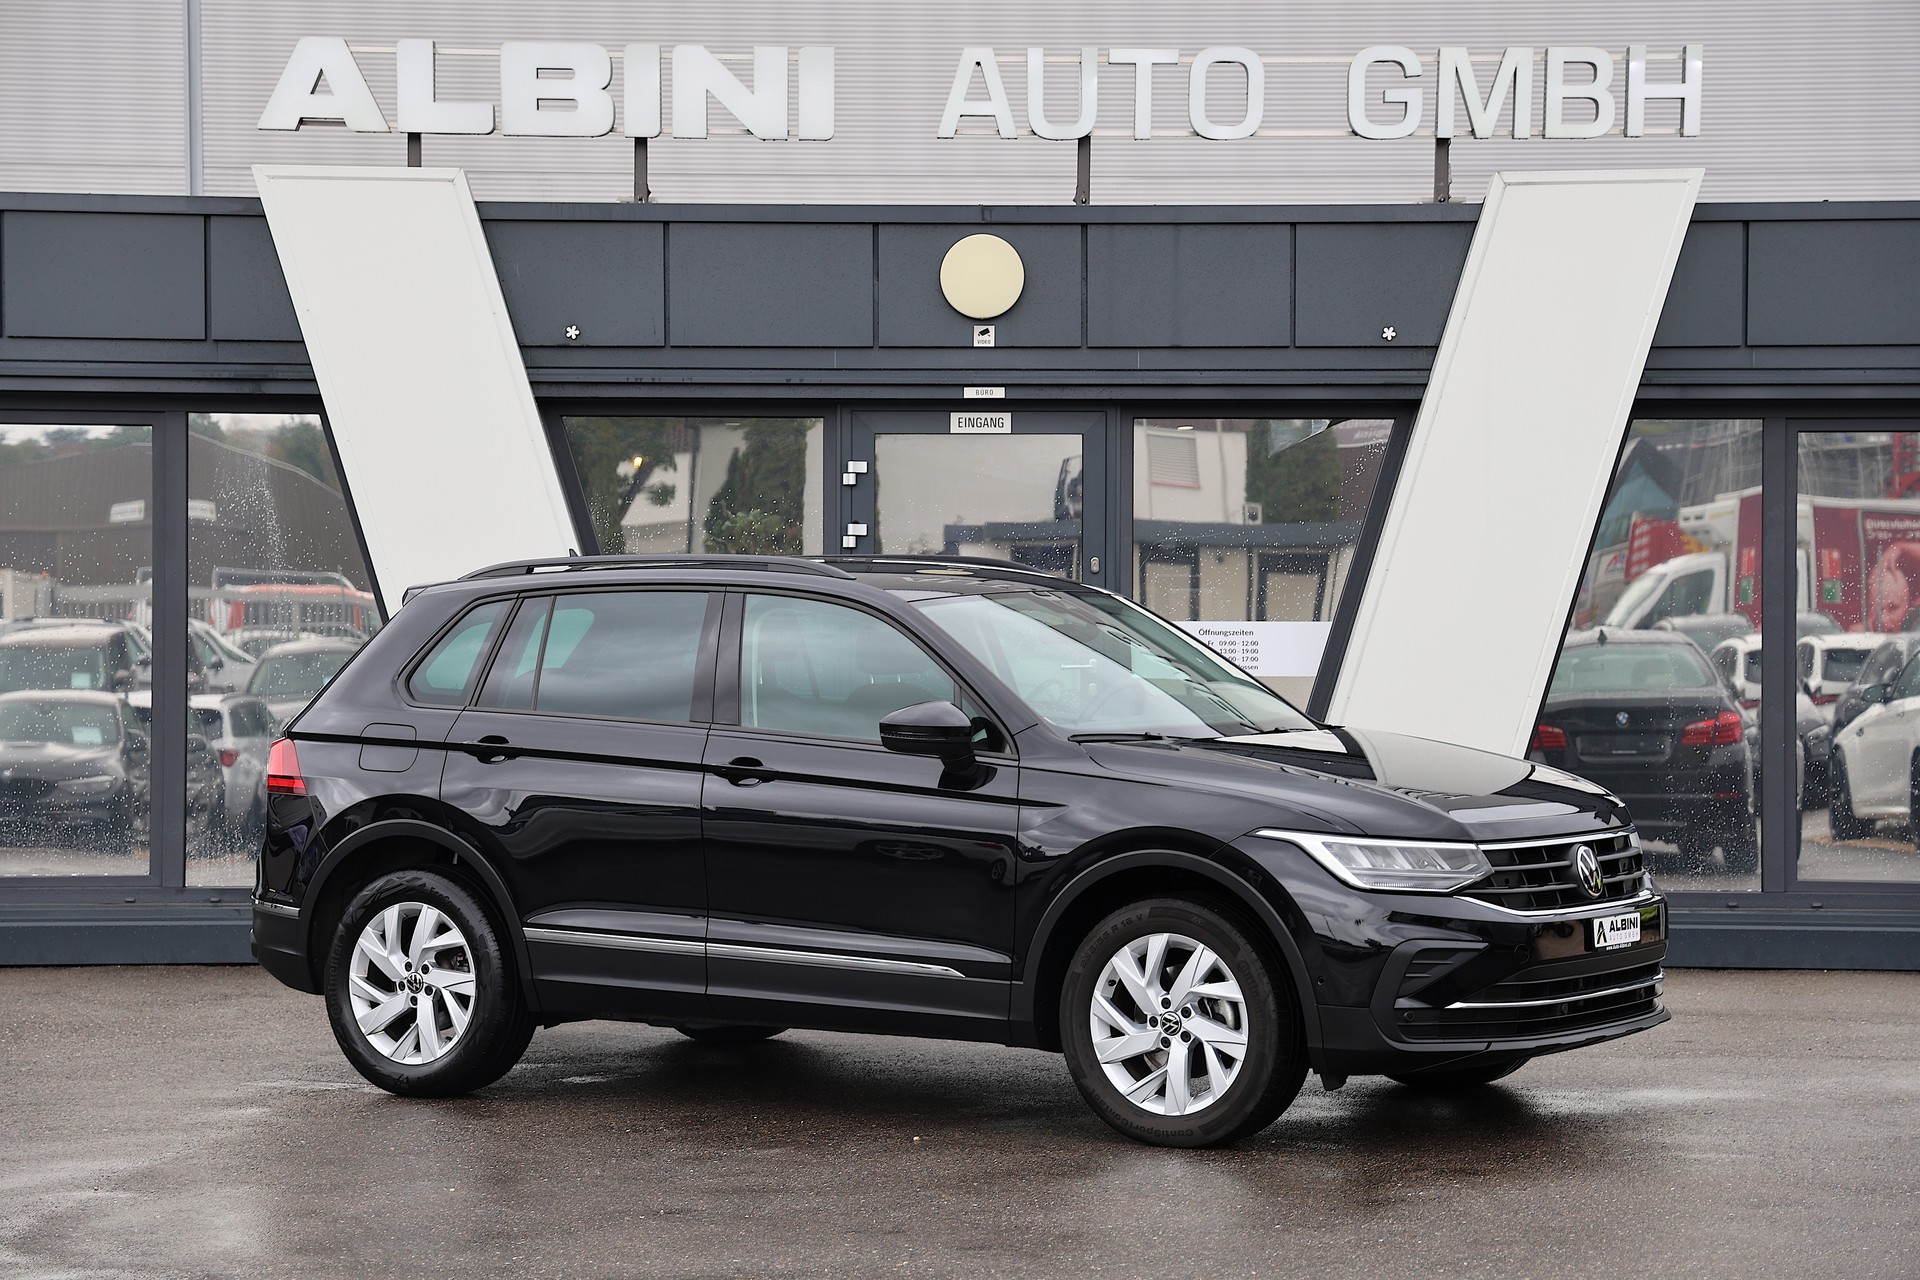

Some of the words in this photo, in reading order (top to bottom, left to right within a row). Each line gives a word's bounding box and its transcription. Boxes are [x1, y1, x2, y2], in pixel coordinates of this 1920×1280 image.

[258, 36, 836, 141] ALBINI
[937, 46, 1265, 141] AUTO
[1347, 44, 1704, 141] GMBH
[975, 388, 994, 396] BÜRO
[957, 417, 1004, 428] EINGANG
[1198, 628, 1254, 637] Öffnungszeiten
[1609, 916, 1638, 932] ALBINI
